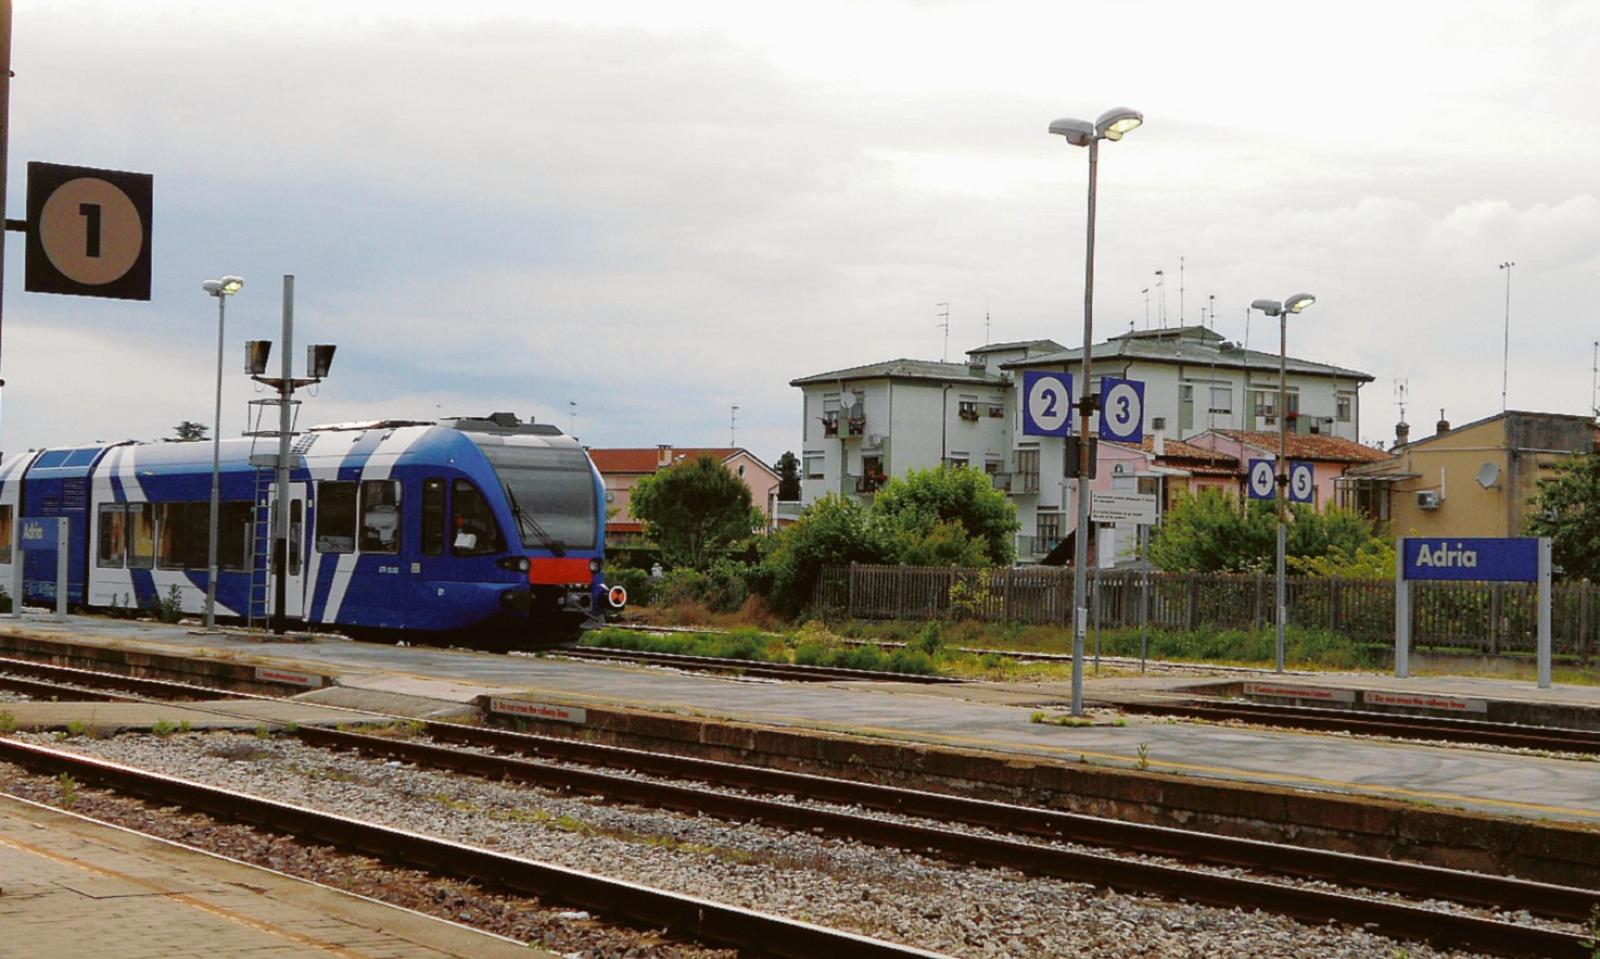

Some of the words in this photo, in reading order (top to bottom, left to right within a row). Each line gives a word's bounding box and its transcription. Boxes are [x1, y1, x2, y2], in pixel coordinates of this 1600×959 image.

[79, 203, 101, 258] 1
[1041, 388, 1057, 417] 2
[1116, 396, 1130, 424] 3
[1258, 470, 1268, 488] 4
[1298, 474, 1306, 491] 5
[1416, 542, 1477, 567] Adria
